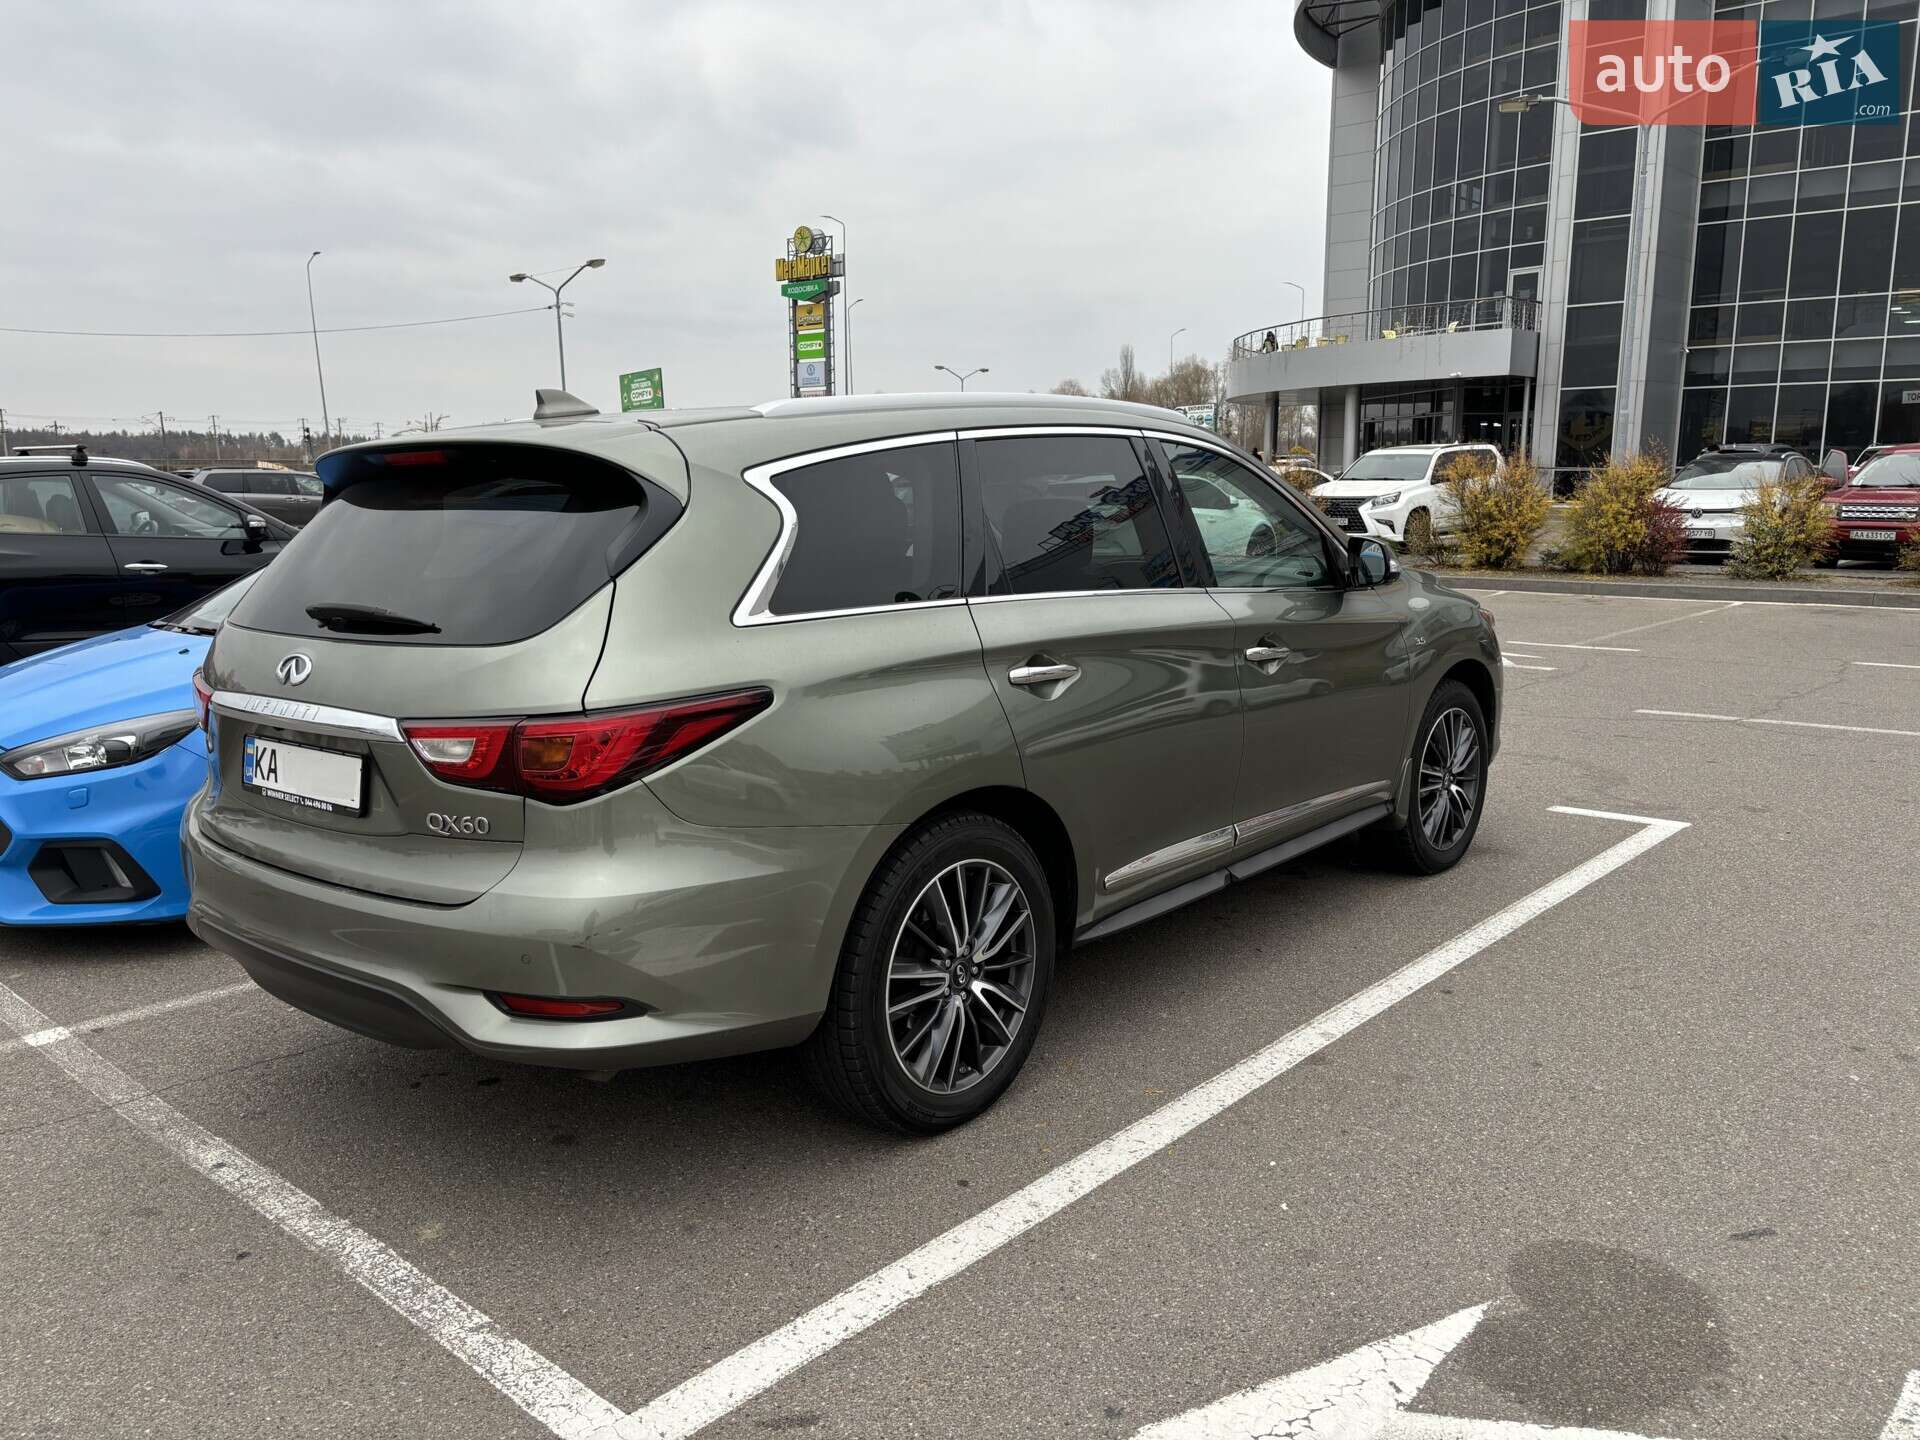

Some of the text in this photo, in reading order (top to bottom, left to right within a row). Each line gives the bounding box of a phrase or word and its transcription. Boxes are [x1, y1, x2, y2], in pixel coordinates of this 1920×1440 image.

[255, 745, 278, 783] KA
[284, 793, 299, 803] SELECT
[426, 812, 489, 836] QX60
